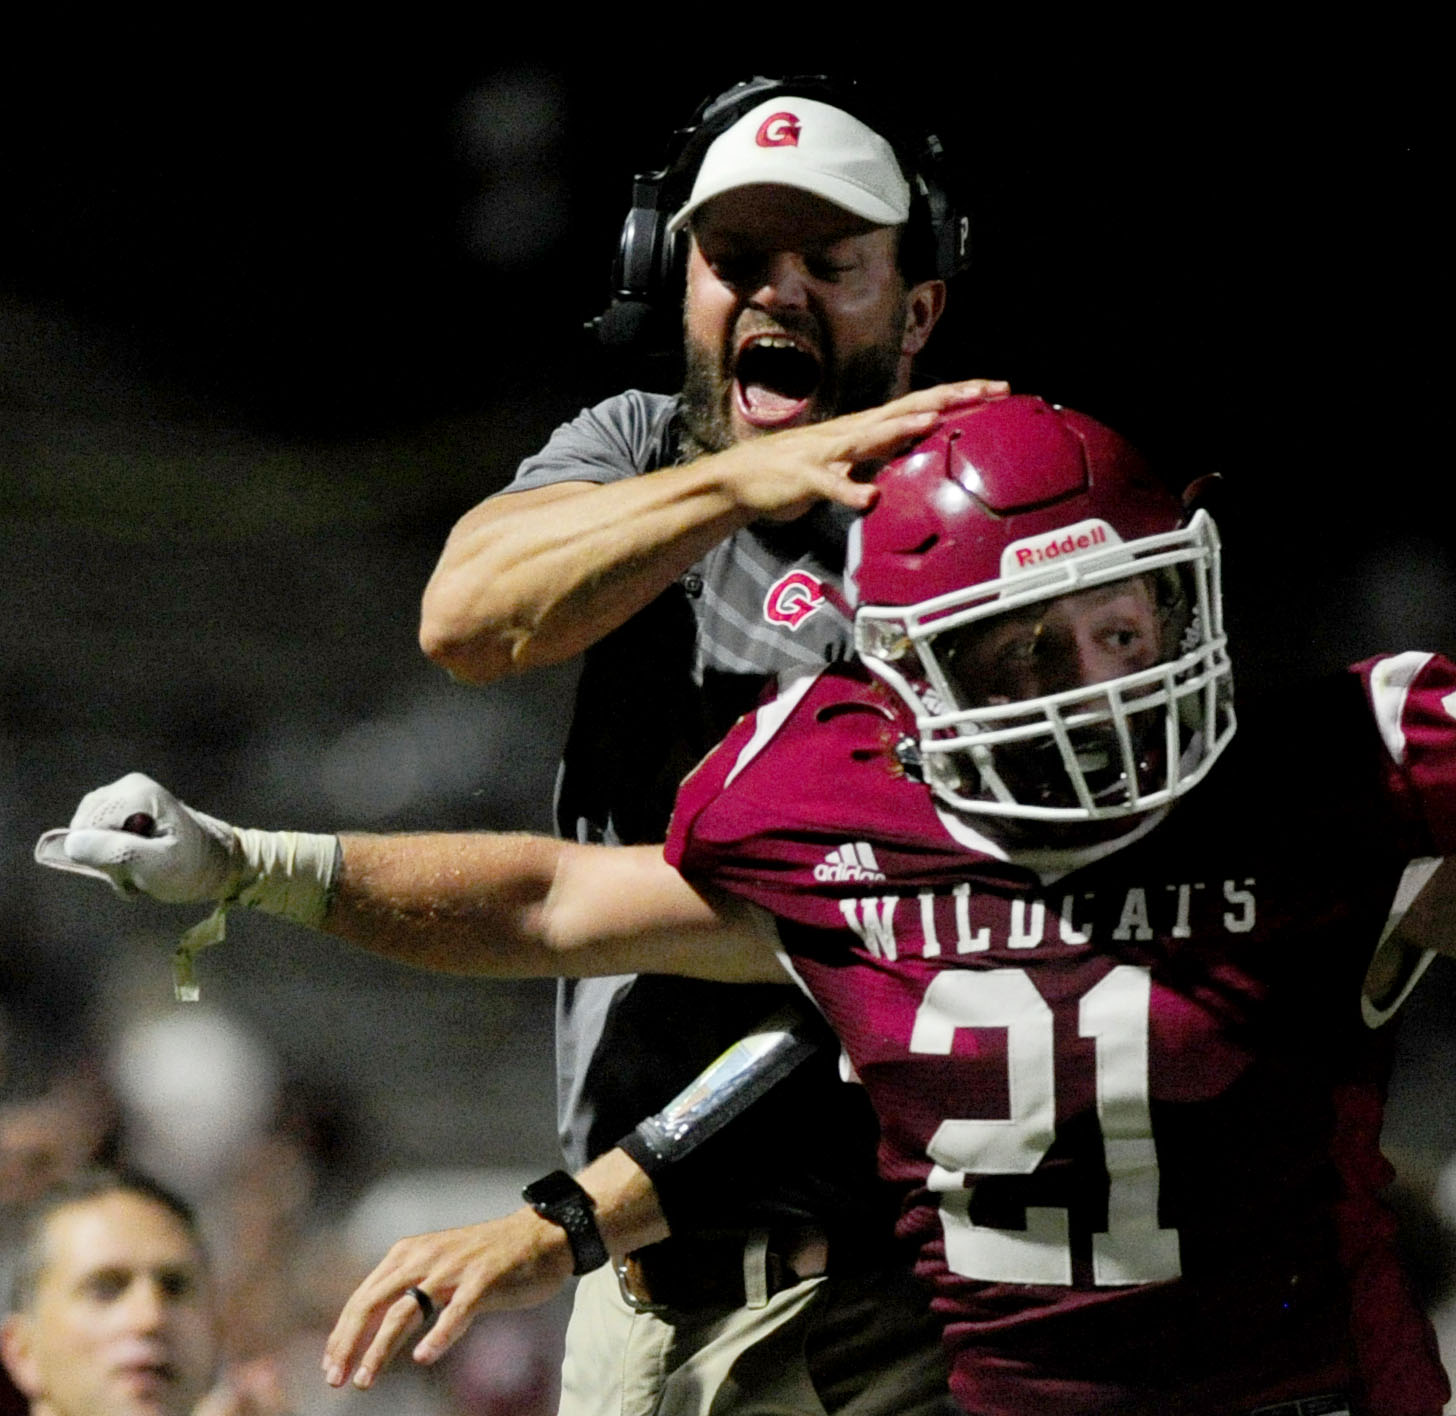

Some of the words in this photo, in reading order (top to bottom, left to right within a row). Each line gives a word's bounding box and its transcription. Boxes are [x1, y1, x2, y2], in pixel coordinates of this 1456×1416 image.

[755, 112, 801, 148] G
[1015, 525, 1107, 567] Riddell
[763, 569, 827, 632] G
[838, 876, 1257, 962] WILDCATS
[908, 964, 1184, 1287] 21
